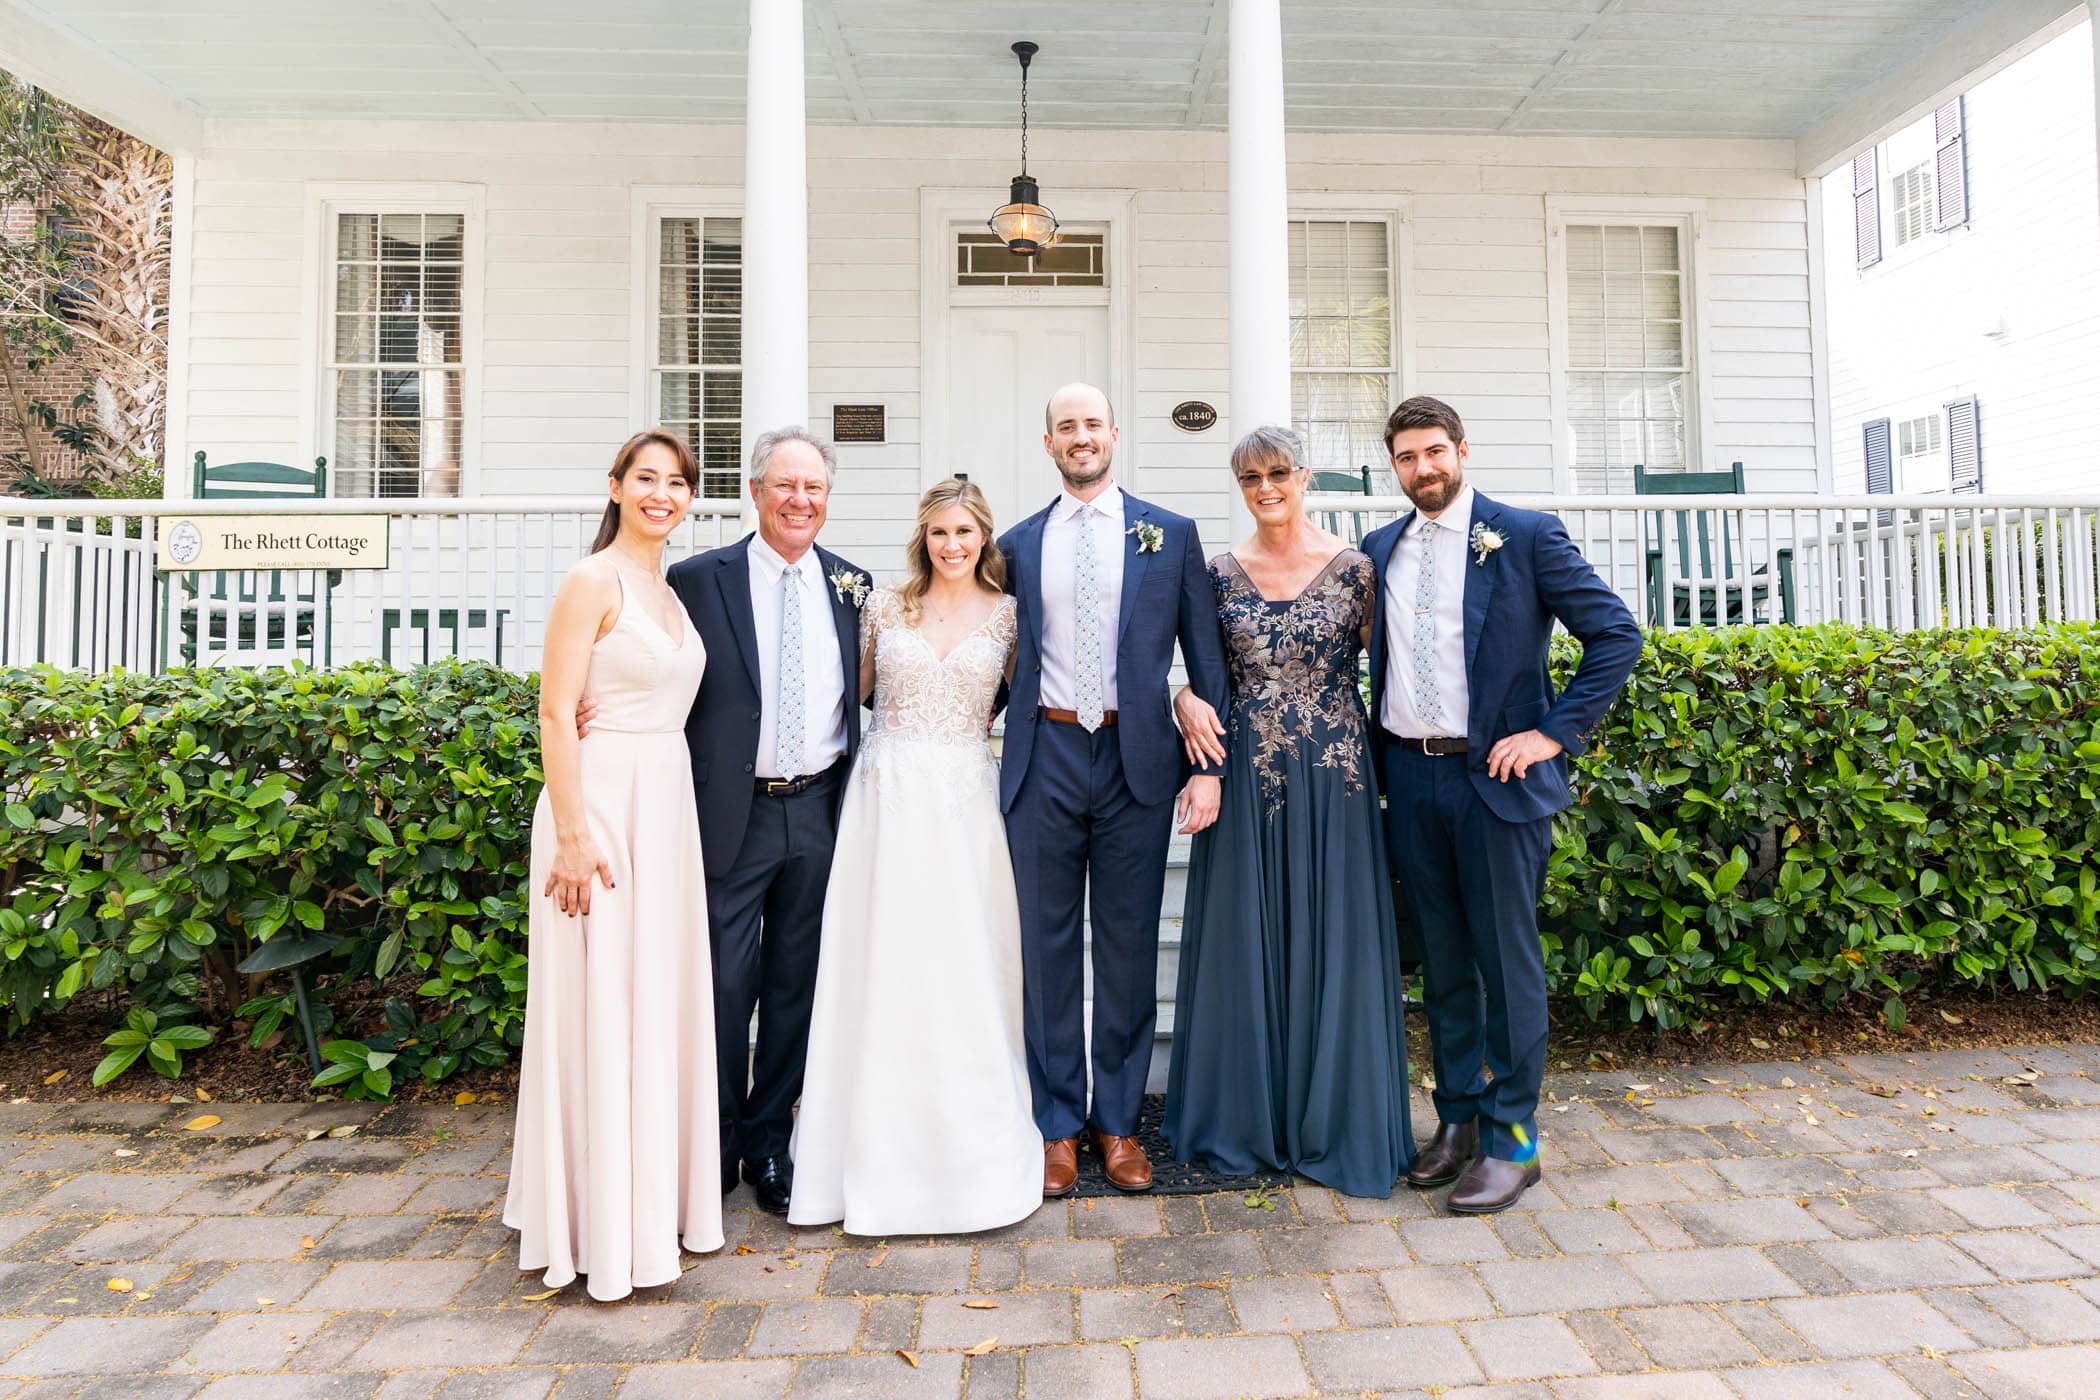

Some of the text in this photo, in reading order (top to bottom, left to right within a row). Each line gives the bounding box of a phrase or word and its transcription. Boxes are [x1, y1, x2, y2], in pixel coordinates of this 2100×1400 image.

[1190, 411, 1211, 421] 1840
[221, 532, 368, 556] The Rhett Cottage
